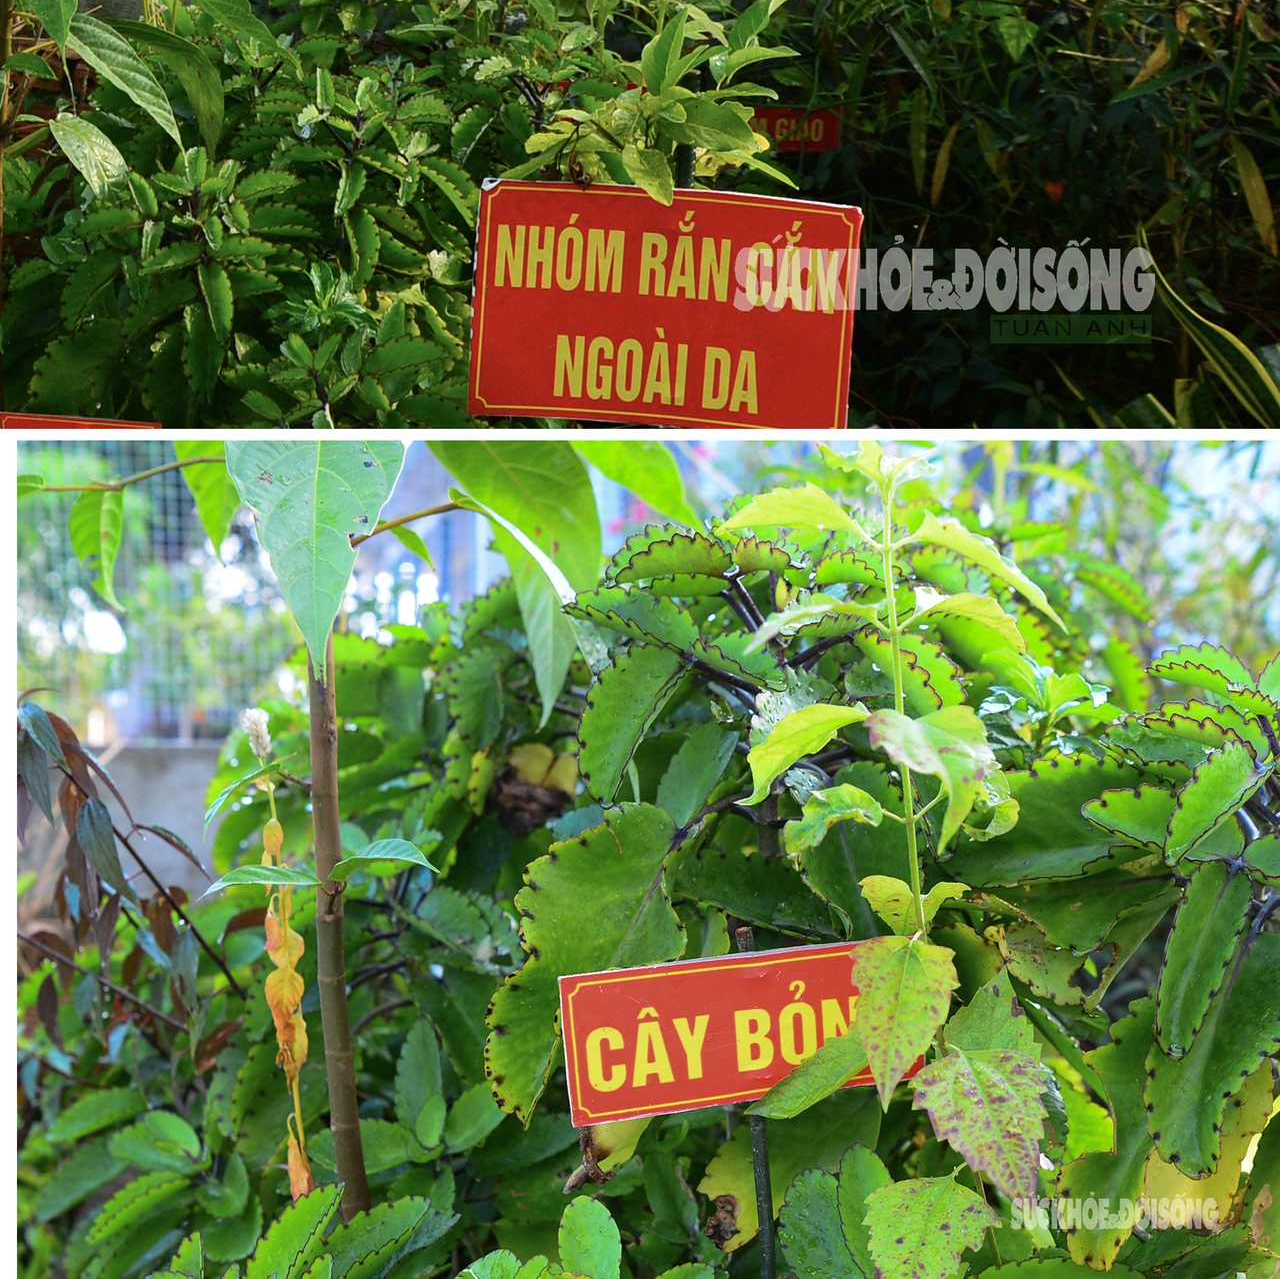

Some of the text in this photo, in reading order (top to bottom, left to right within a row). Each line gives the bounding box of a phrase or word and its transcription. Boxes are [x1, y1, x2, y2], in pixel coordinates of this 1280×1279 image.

[494, 213, 626, 293] NHÓM
[638, 210, 733, 302] RẮN
[553, 327, 759, 415] NGOÀI DA
[585, 980, 860, 1093] CÂY BỎN
